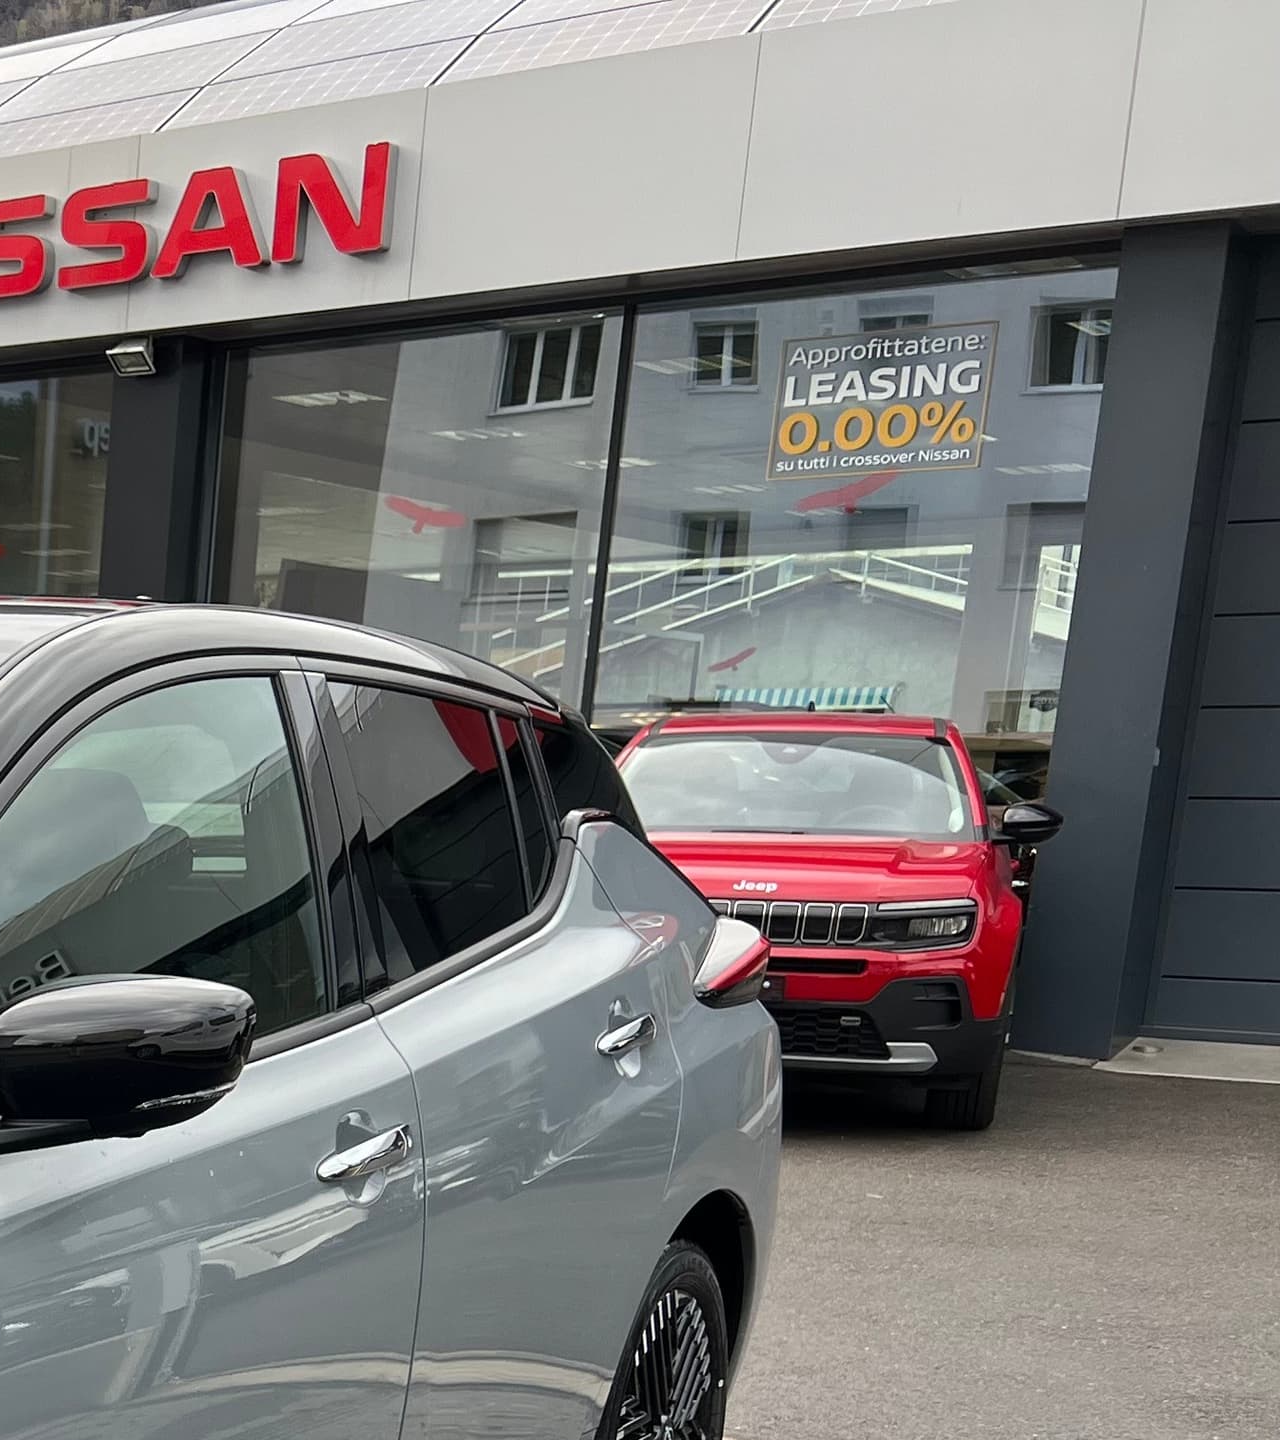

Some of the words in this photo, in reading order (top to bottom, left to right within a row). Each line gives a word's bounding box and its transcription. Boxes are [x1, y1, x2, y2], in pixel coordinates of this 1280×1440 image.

[788, 333, 987, 370] Approfittatene:
[783, 360, 982, 408] LEASING
[778, 400, 976, 455] 0.00%
[776, 459, 794, 473] su
[797, 454, 830, 470] tutti
[840, 451, 915, 467] crossover
[918, 448, 971, 463] Nissan
[732, 879, 778, 894] Jeep
